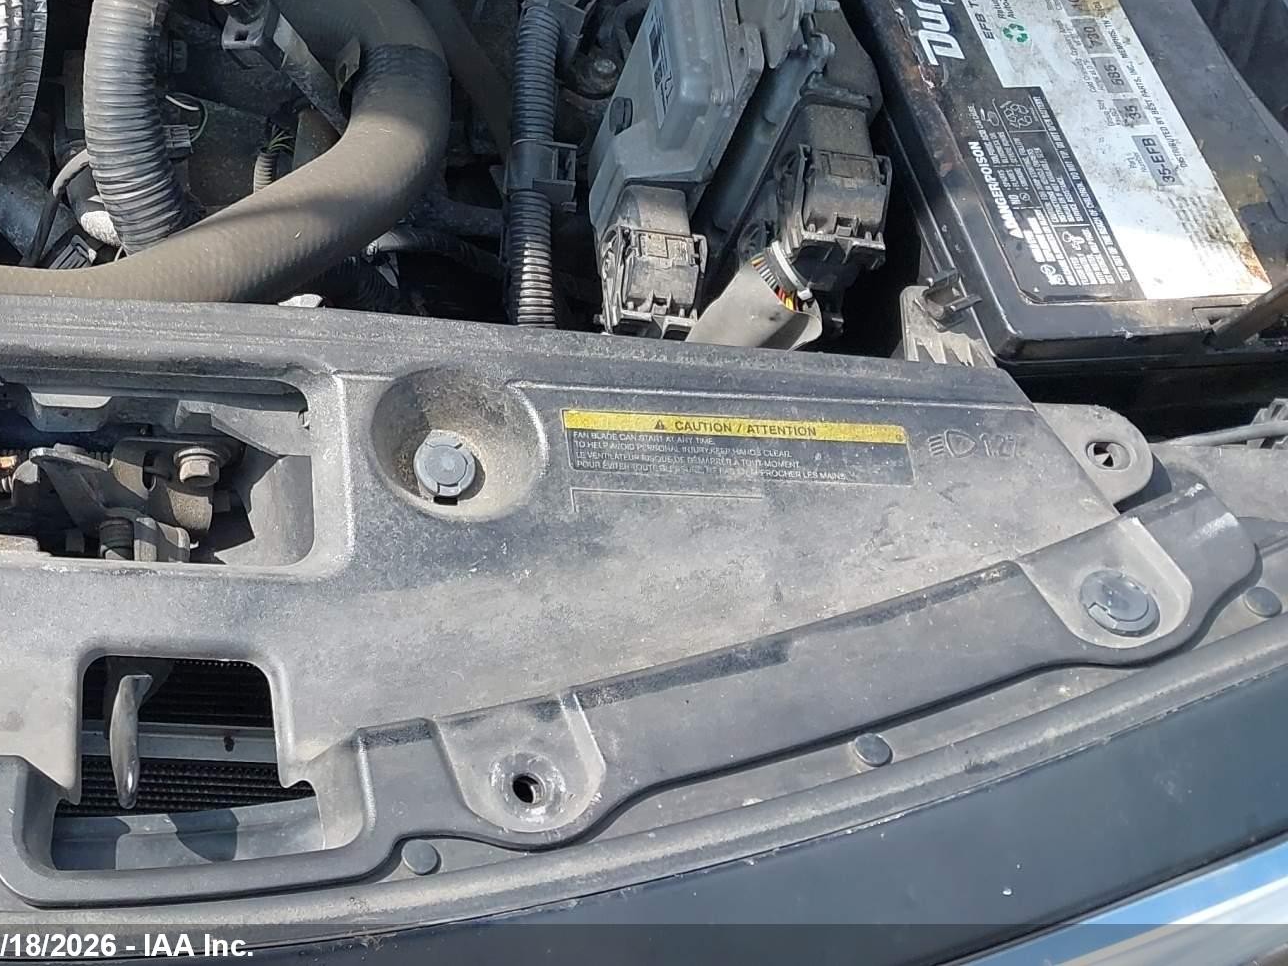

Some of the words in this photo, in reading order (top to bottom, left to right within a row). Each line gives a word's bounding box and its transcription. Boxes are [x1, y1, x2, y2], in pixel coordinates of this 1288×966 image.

[973, 12, 995, 39] EFB
[1082, 26, 1103, 45] 730
[1123, 105, 1142, 118] 35
[1159, 126, 1188, 167] DISTRIBUTED
[1139, 137, 1176, 182] 35-EFB
[968, 141, 1019, 228] DANGER/POISON
[1007, 194, 1021, 204] NO
[591, 433, 617, 441] BLADE
[620, 433, 636, 441] CAN
[675, 420, 732, 433] CAUTION
[746, 424, 816, 437] ATTENTION
[587, 441, 608, 449] HELP
[577, 461, 601, 469] POUR
